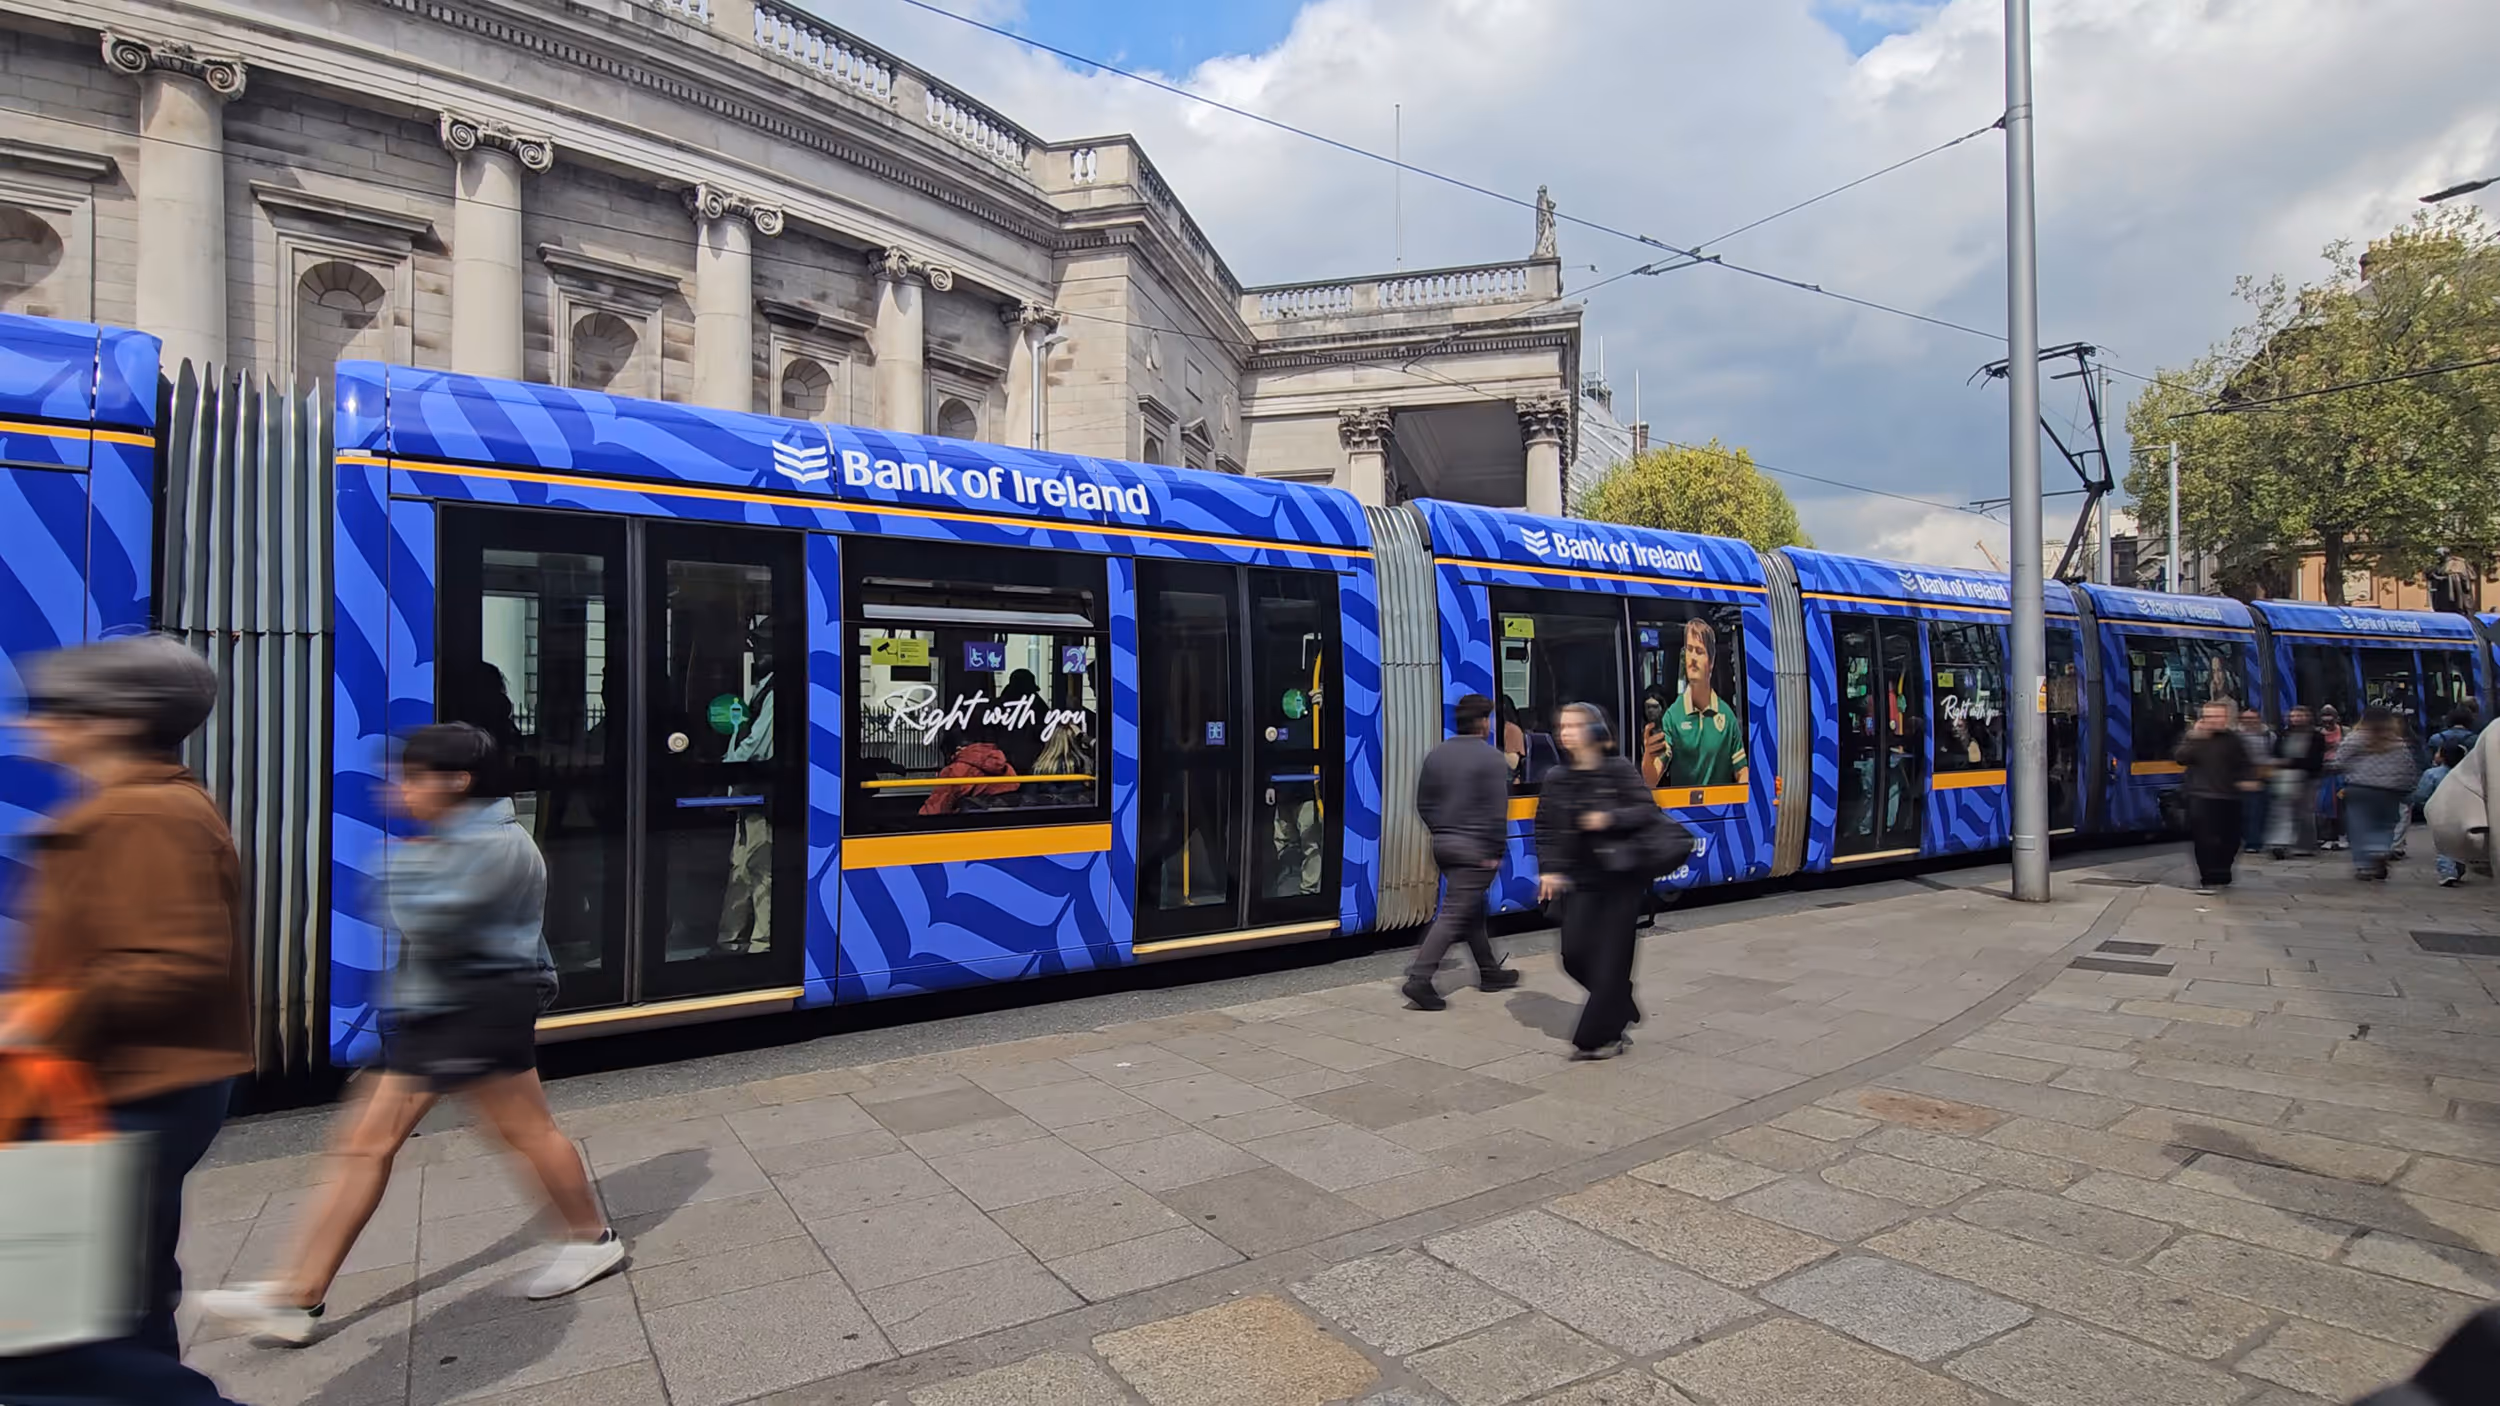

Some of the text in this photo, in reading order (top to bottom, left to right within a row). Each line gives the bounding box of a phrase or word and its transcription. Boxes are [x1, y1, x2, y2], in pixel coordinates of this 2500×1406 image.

[842, 449, 1151, 516] Bank of Ireland
[1551, 532, 1703, 572] Bank of Ireland
[1915, 573, 2009, 602] Bank of Ireland
[884, 684, 1087, 746] Right with you
[1941, 694, 1973, 727] Right
[1969, 700, 1986, 721] with
